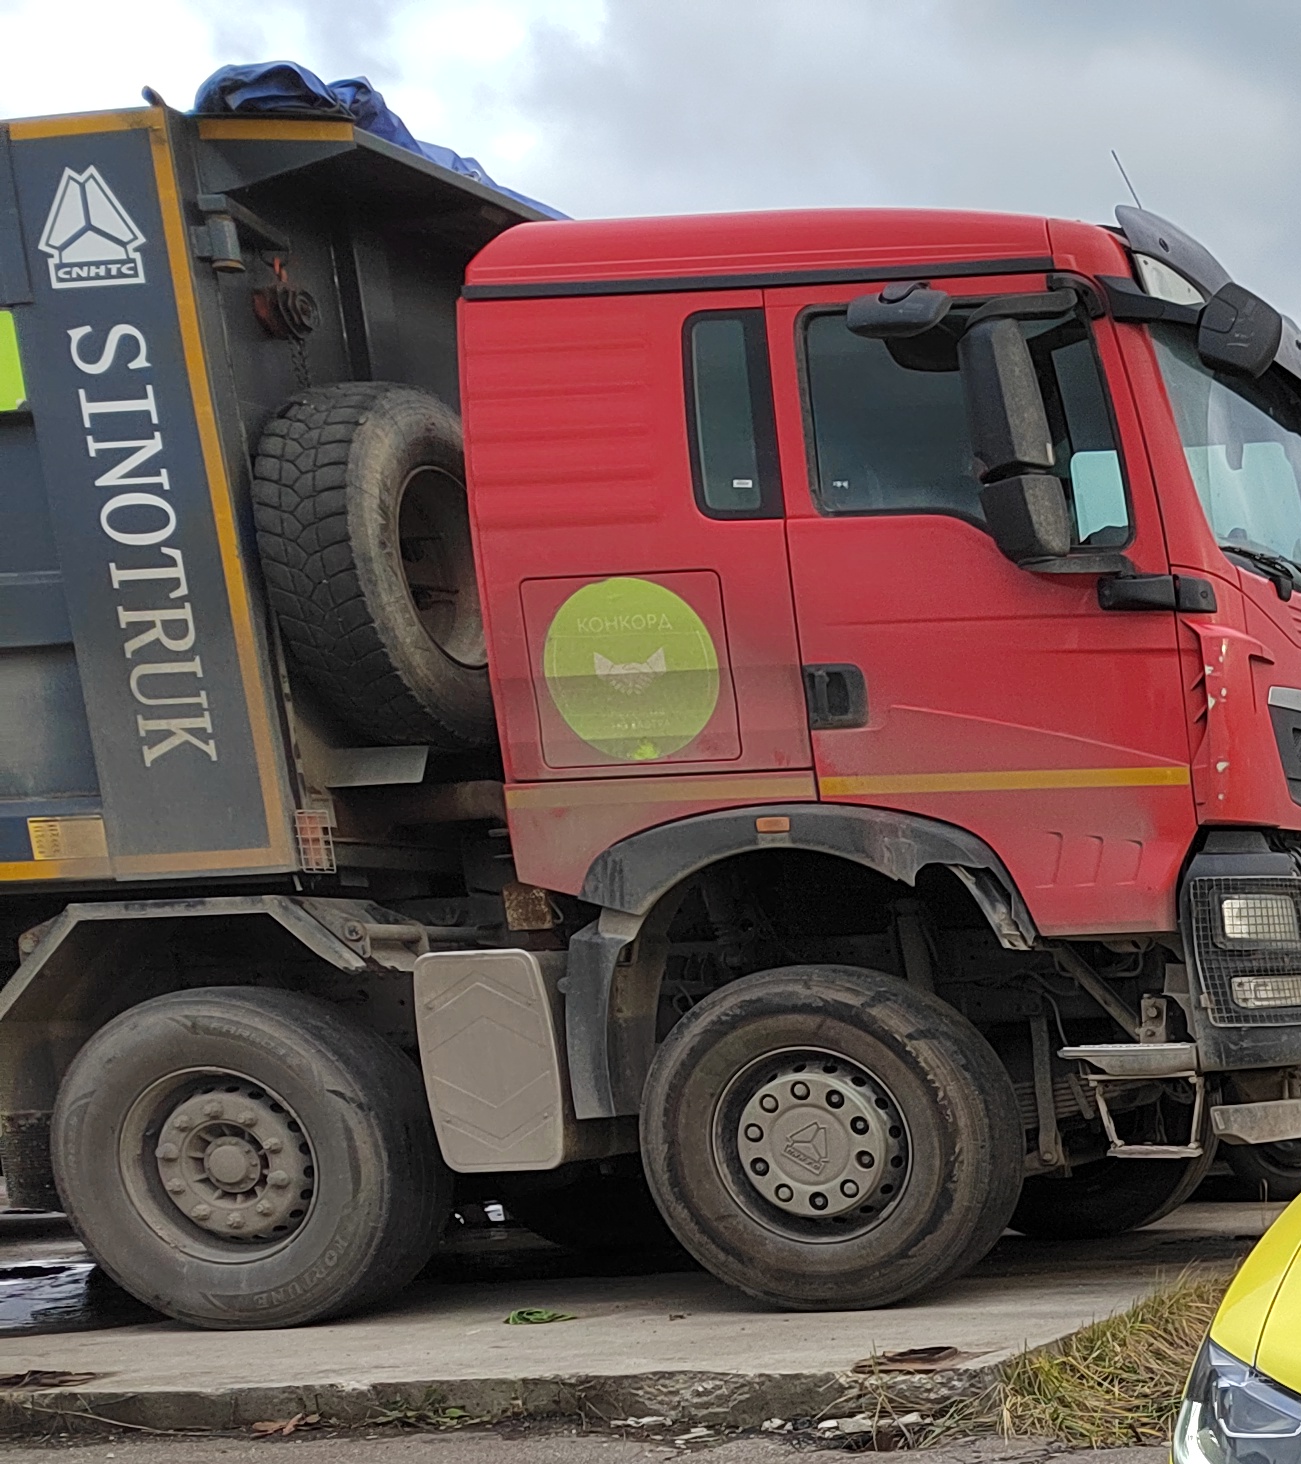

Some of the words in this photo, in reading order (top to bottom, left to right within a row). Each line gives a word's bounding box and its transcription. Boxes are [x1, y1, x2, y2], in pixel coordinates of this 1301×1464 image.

[57, 263, 135, 279] CNHTC
[66, 323, 218, 768] SINOTRUK
[576, 613, 673, 634] КОНКОРД
